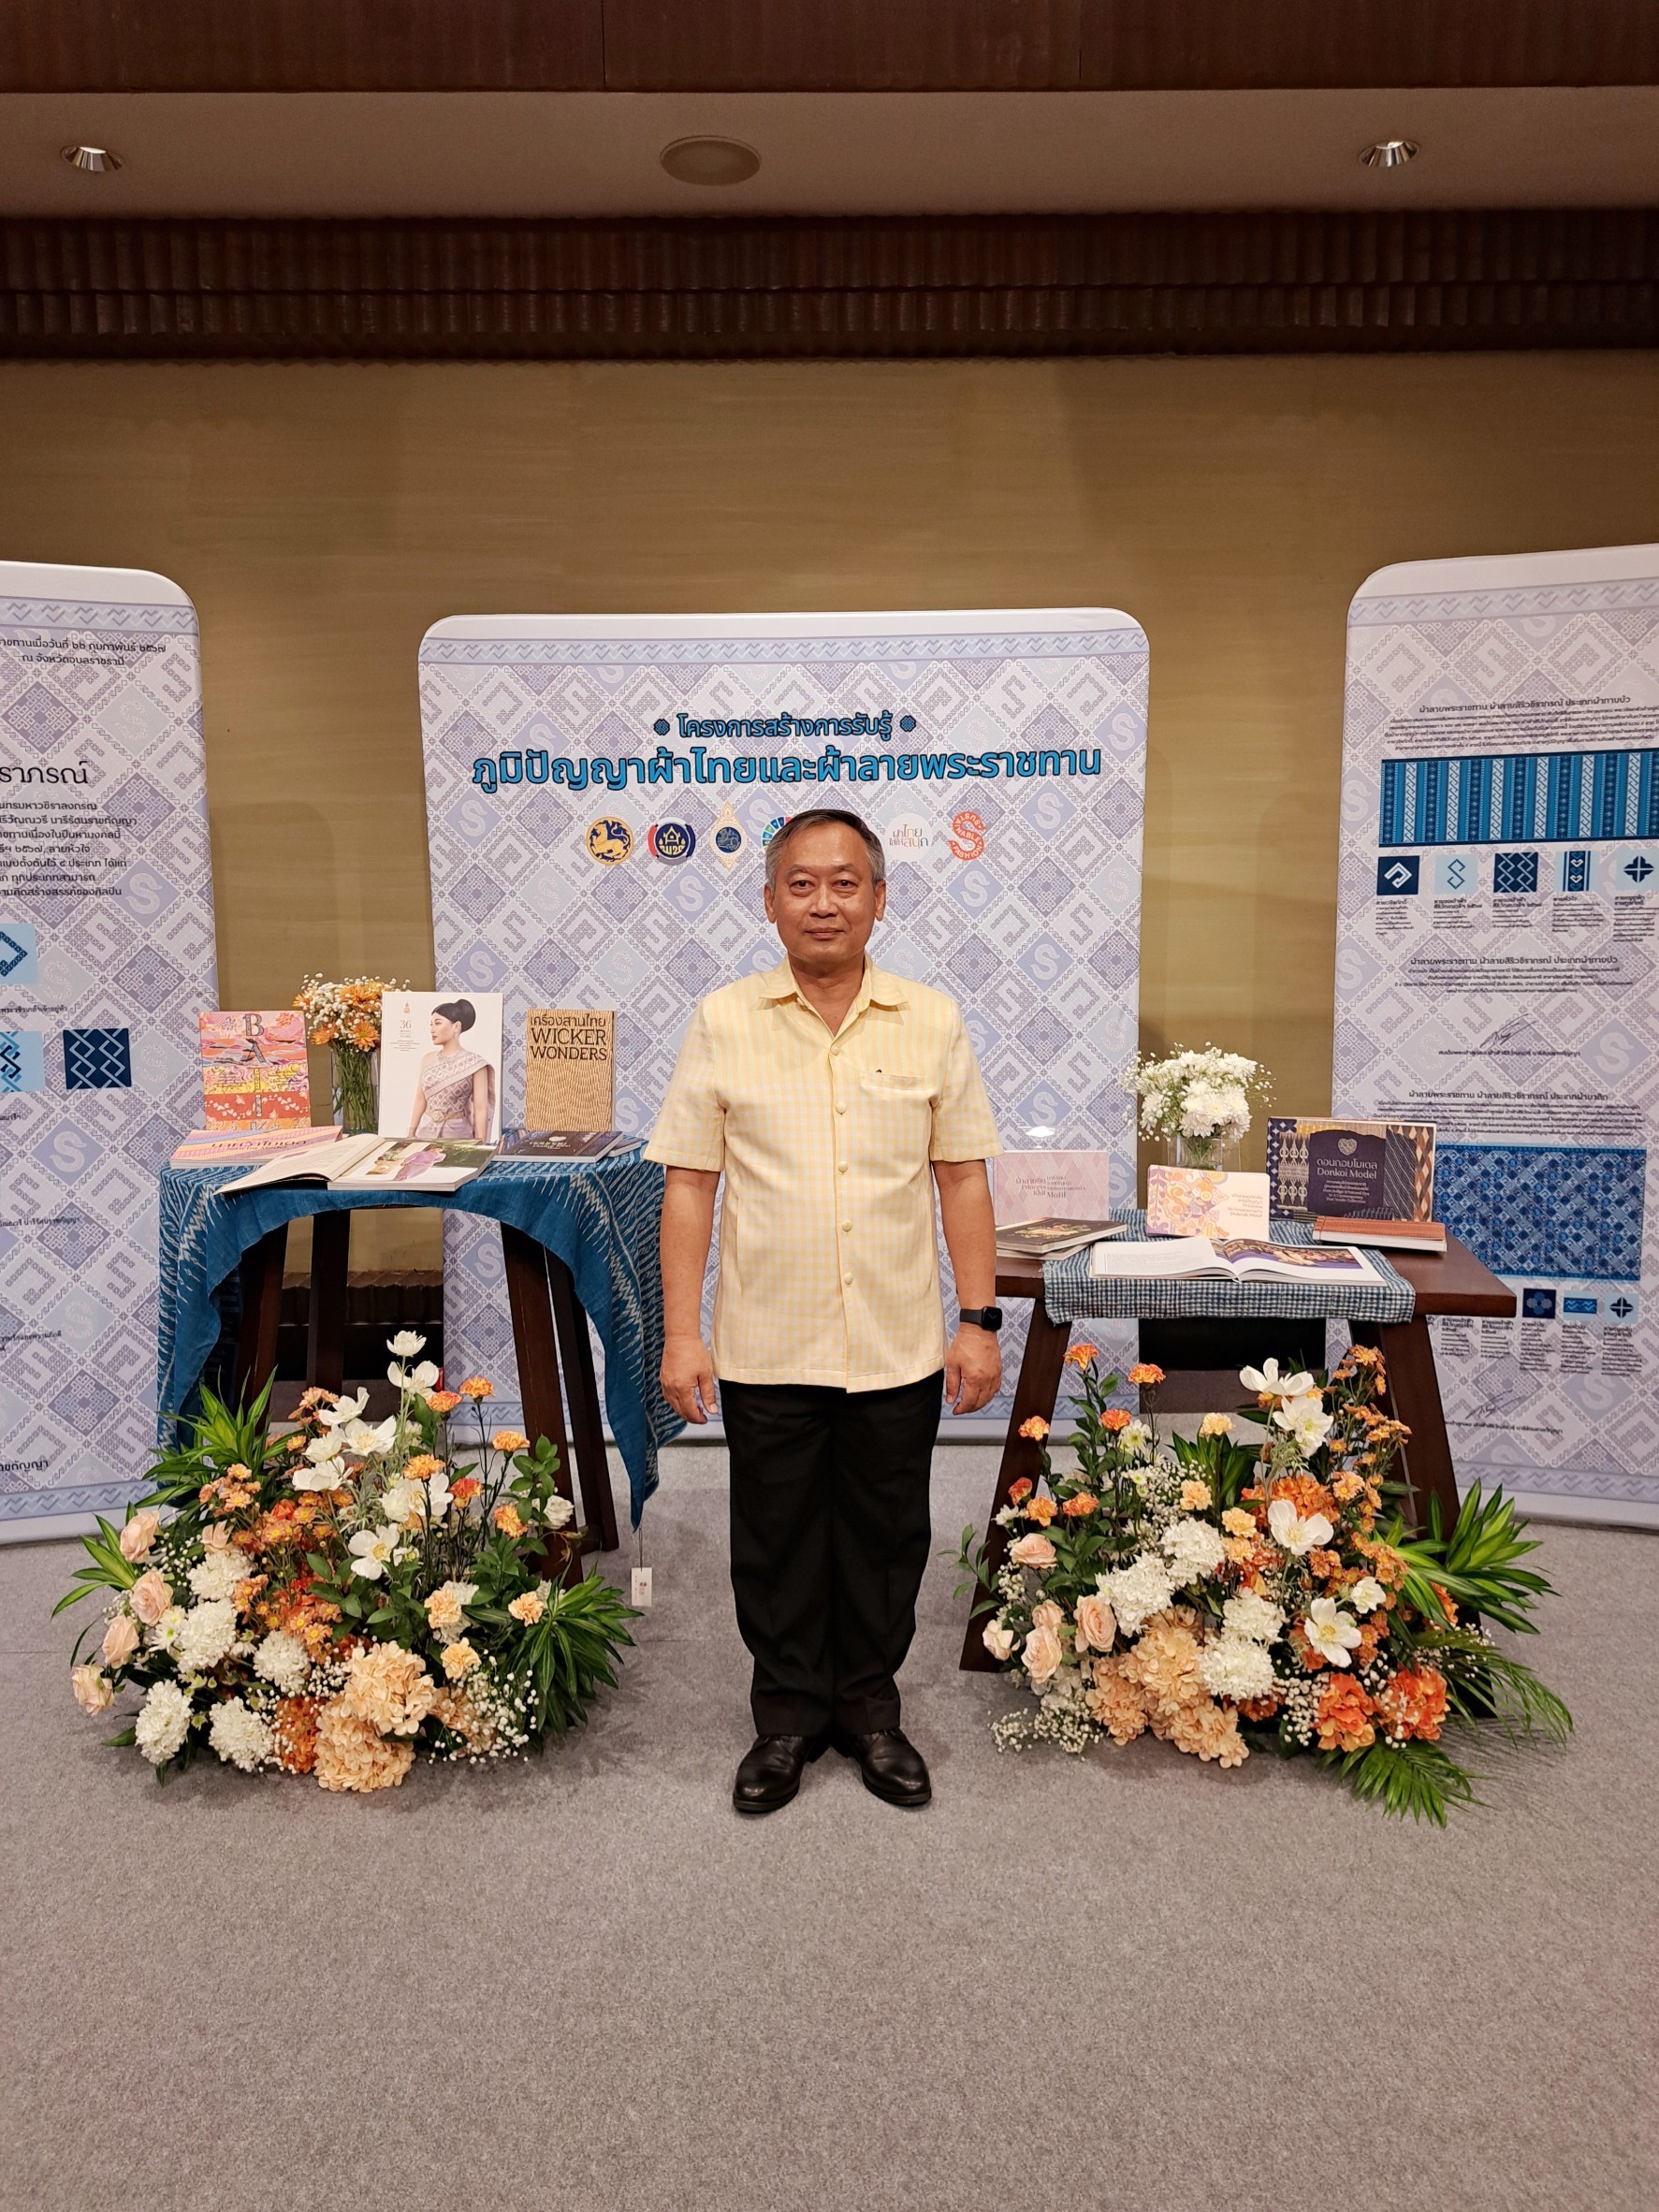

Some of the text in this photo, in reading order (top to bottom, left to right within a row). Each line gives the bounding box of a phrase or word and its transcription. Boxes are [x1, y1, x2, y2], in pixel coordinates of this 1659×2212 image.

[677, 710, 894, 741] โครงการสร้างการรับรู้
[472, 745, 1101, 793] ภูมิปัญญาผ้าไทยและผ้าลายพระราชทาน
[530, 1013, 606, 1027] เครื่องสานไทย
[531, 1027, 607, 1046] WICKER
[530, 1045, 607, 1061] WONDERS
[1317, 1167, 1377, 1179] Donkoi Model
